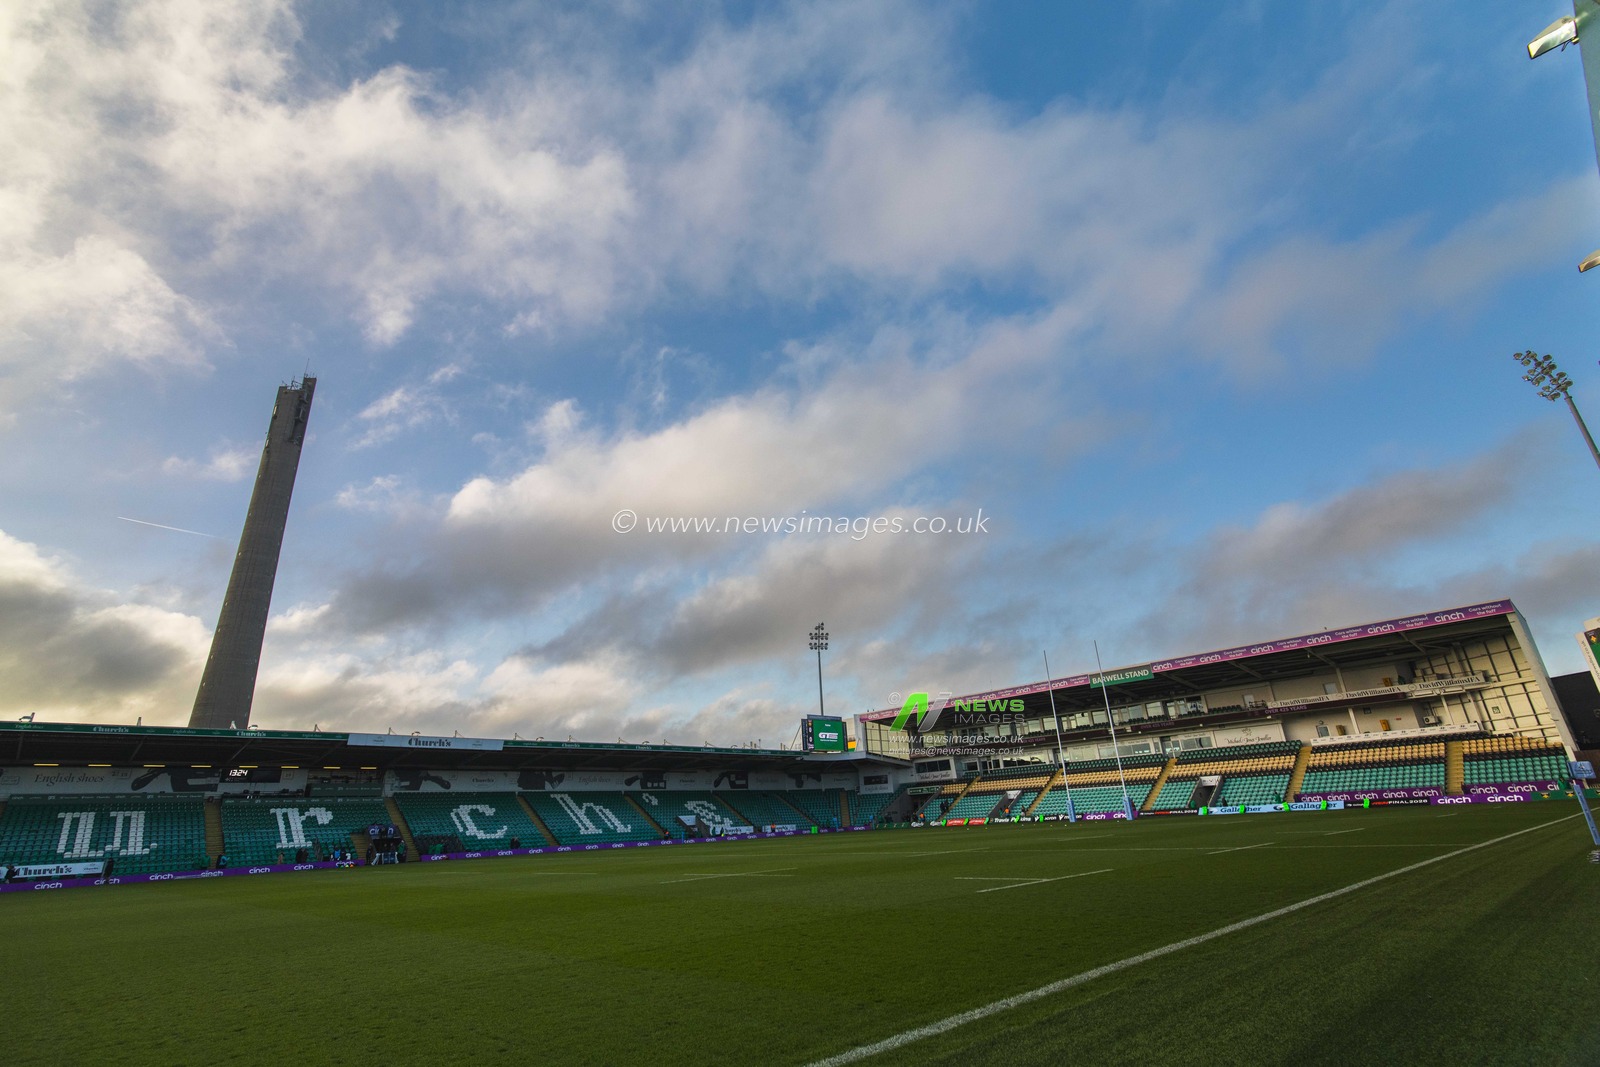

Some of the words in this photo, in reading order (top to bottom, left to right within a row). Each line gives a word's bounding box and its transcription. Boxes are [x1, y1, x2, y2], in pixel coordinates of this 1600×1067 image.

[1435, 612, 1465, 623] cinch
[1367, 623, 1395, 635] cinch
[1307, 634, 1332, 645] cinch
[1251, 644, 1274, 655] cinch
[1200, 653, 1221, 663] cinch
[1153, 662, 1173, 673] cinch
[1092, 672, 1124, 685] BARWELL
[1125, 669, 1149, 679] STAND
[1051, 680, 1068, 689] cinch
[1015, 686, 1031, 695] cinch
[982, 693, 997, 702] cinch
[1291, 704, 1308, 712] YEARS
[408, 738, 452, 748] Church's
[34, 773, 74, 787] English
[77, 773, 104, 783] shoes
[1327, 793, 1350, 801] cinch
[1354, 790, 1379, 800] cinch
[1382, 788, 1408, 799] cinch
[1412, 786, 1439, 798] cinch
[1470, 784, 1499, 795] cinch
[1507, 781, 1538, 793] cinch
[1437, 794, 1472, 805] cinch
[1487, 792, 1524, 803] cinch
[1290, 802, 1337, 812] Gallager
[34, 882, 63, 890] cinch
[149, 873, 174, 881] cinch
[200, 869, 224, 877] cinch
